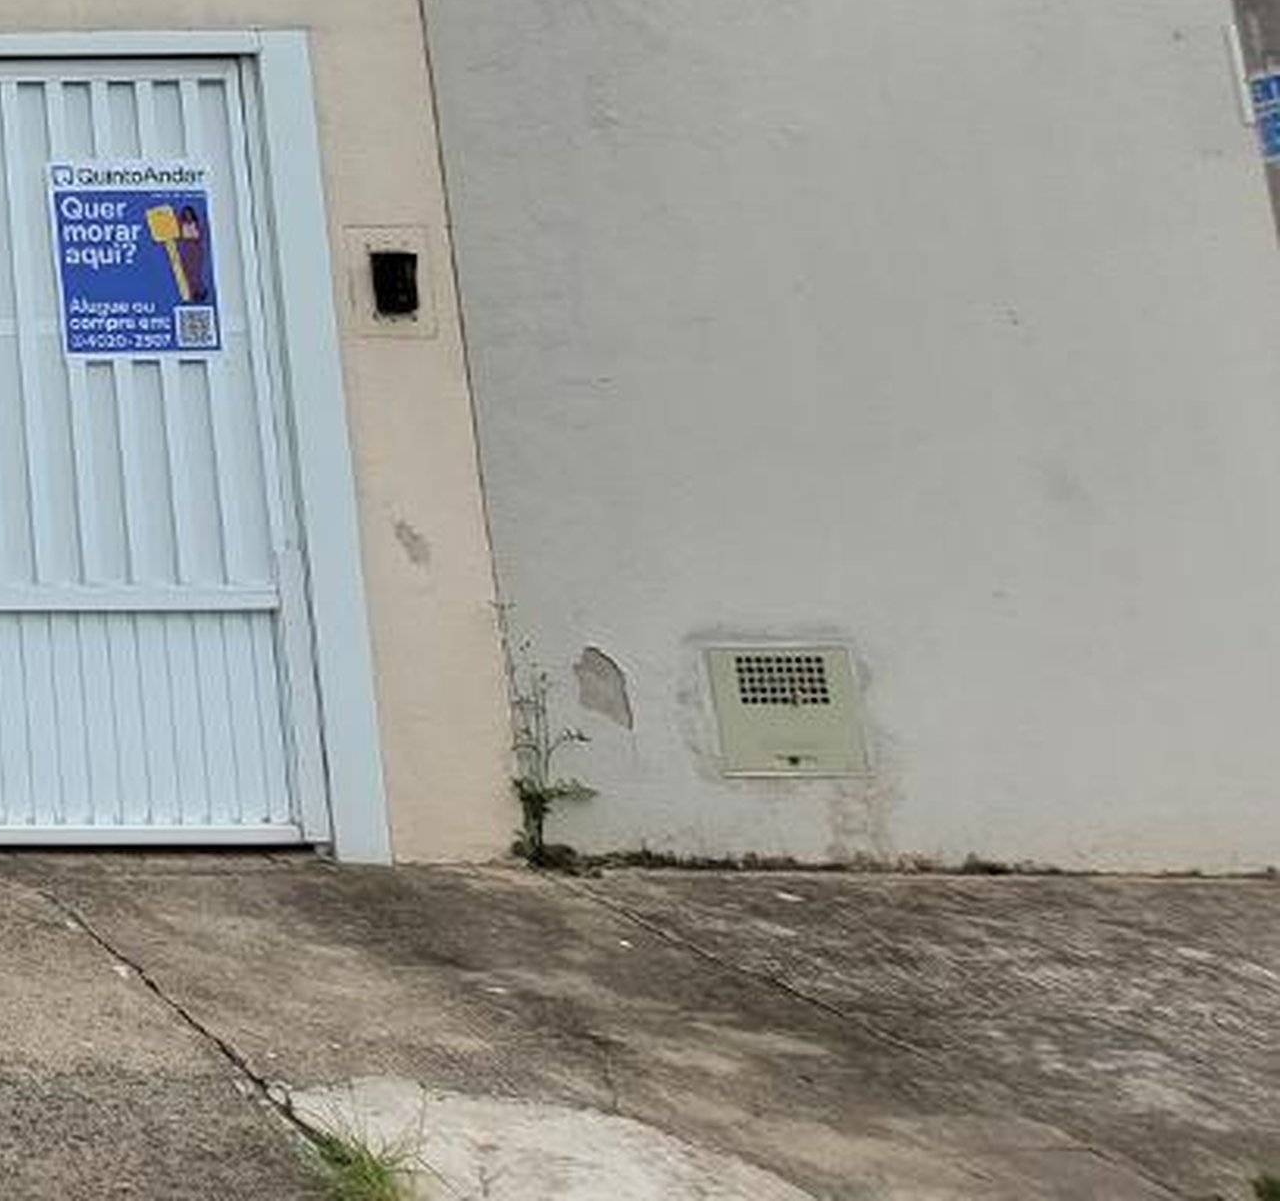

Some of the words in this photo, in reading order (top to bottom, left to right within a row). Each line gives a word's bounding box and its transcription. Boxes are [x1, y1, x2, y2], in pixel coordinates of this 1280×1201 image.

[77, 167, 204, 185] QuintoAndar
[61, 197, 127, 219] Quer
[63, 223, 141, 242] morar
[65, 242, 138, 269] aqui?
[69, 297, 130, 317] Alugue
[132, 302, 156, 313] ou
[69, 317, 136, 332] compra
